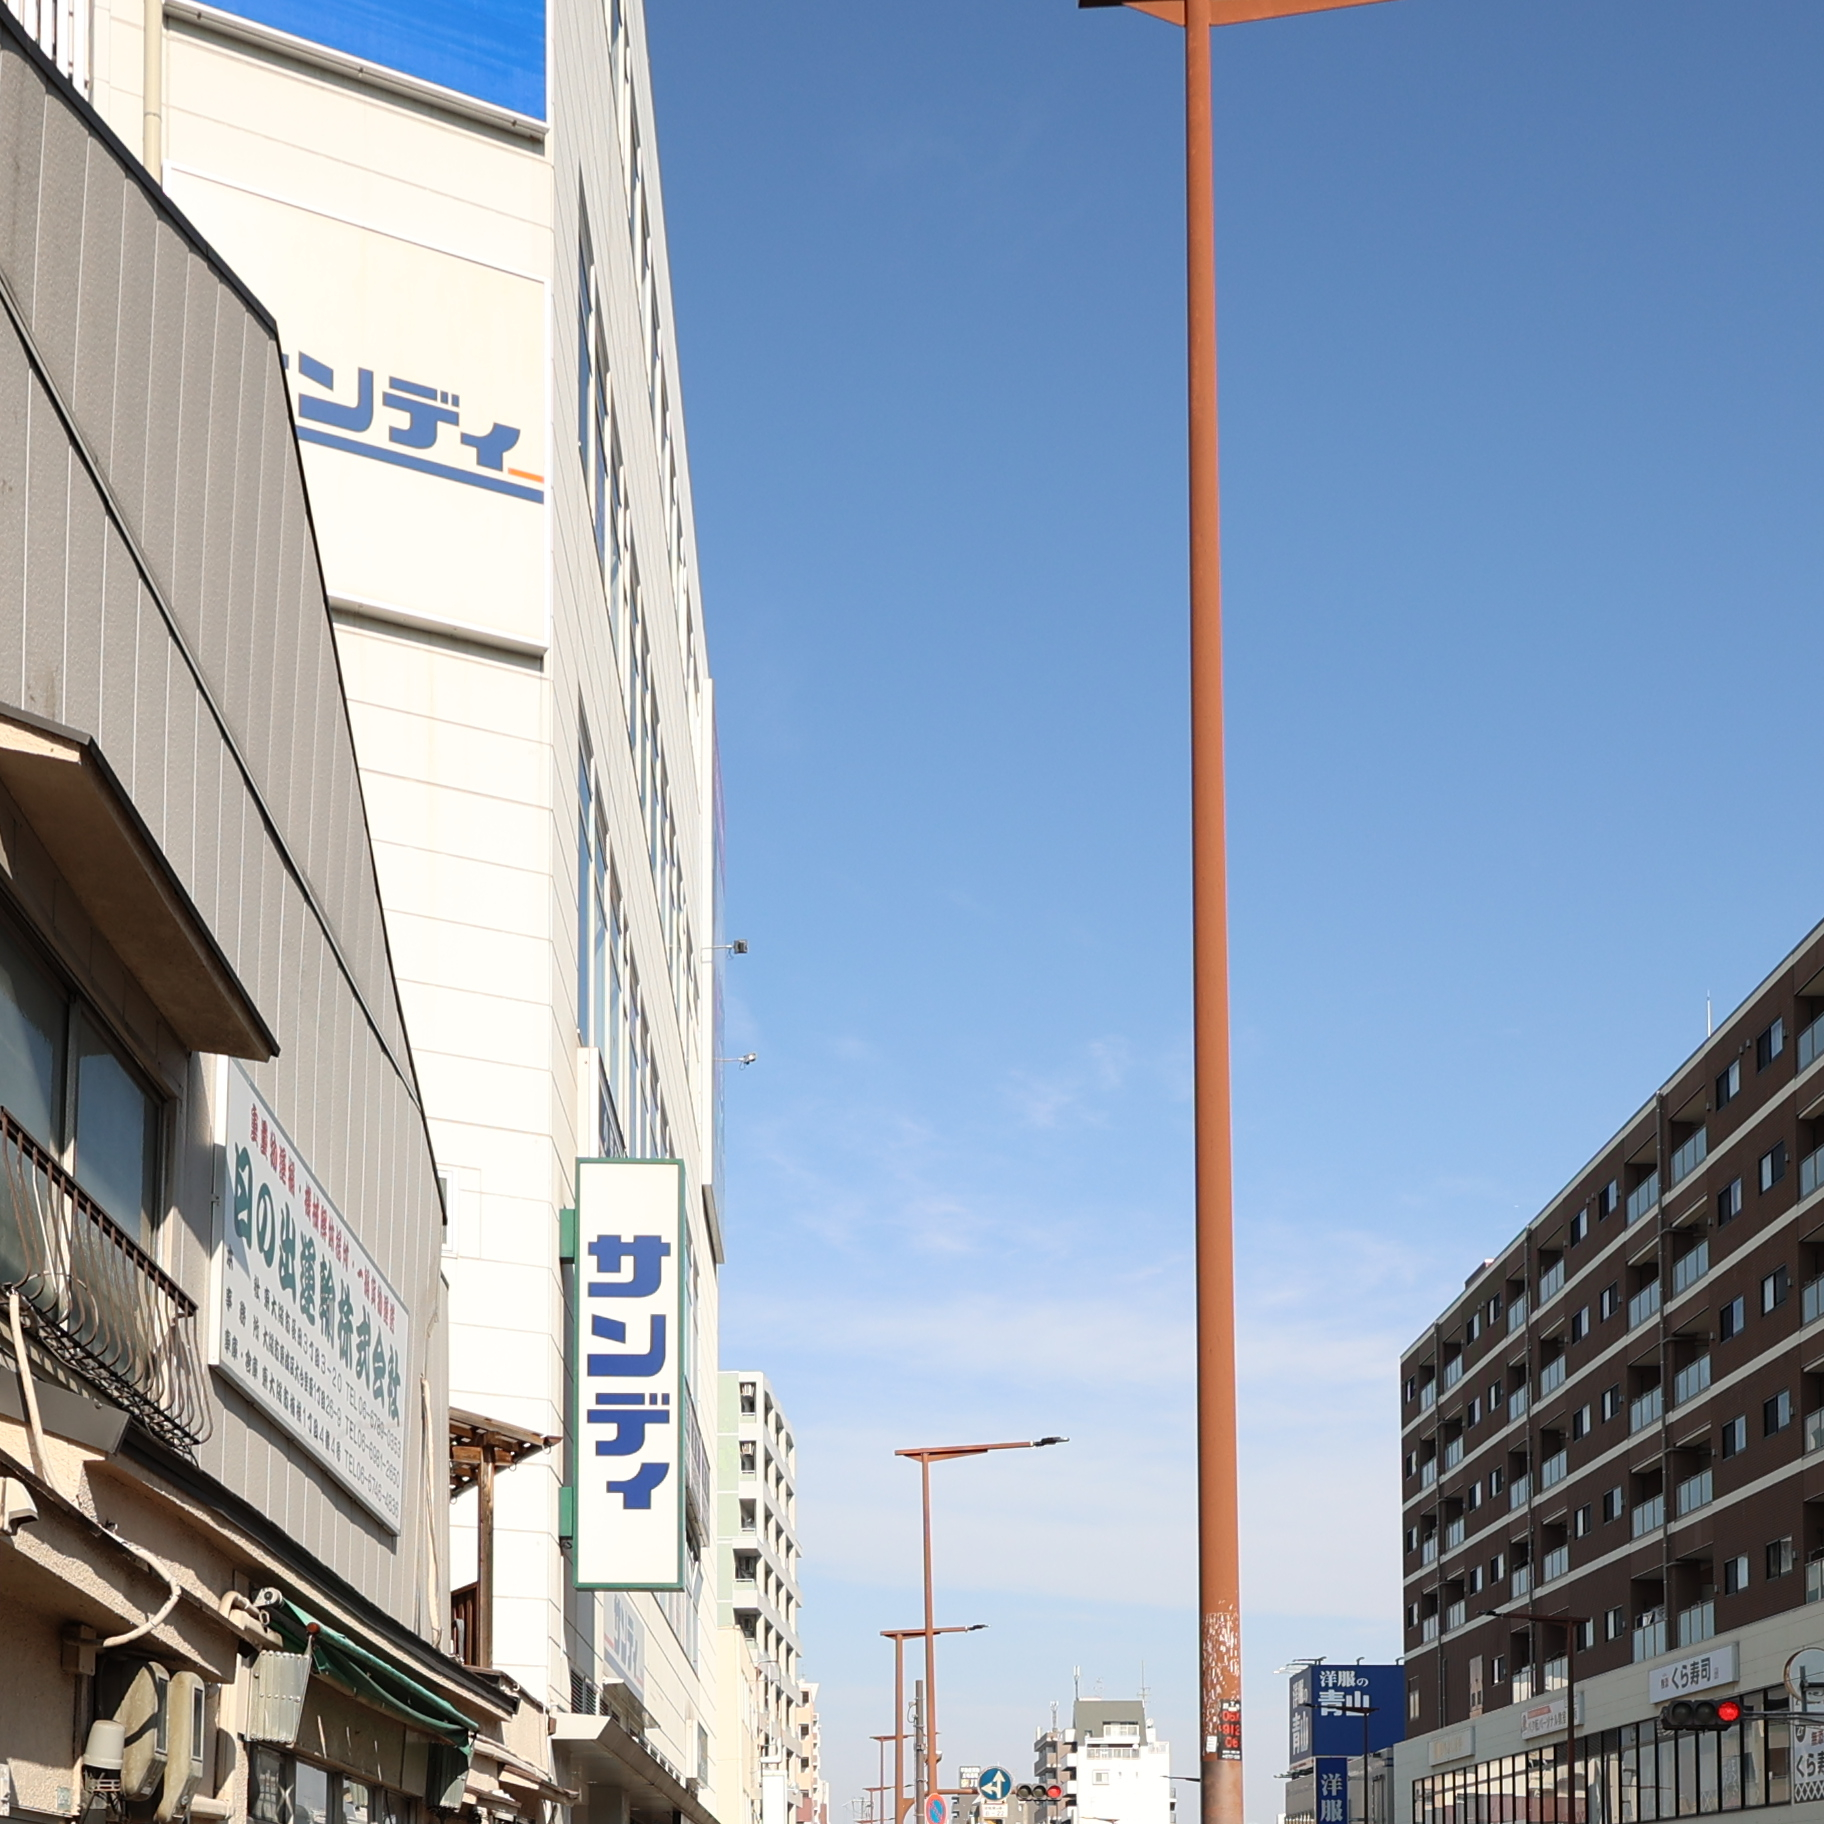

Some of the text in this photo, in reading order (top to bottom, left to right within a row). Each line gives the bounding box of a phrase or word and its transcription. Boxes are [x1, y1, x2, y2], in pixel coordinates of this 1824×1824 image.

[281, 351, 521, 472] ンディ
[233, 1141, 401, 1426] 日の出運輸株式会社
[587, 1234, 671, 1510] サンディ
[1320, 1671, 1368, 1688] 洋服の
[1672, 1657, 1710, 1690] くら寿司
[1318, 1689, 1370, 1717] 青山
[1292, 1712, 1308, 1757] 青山
